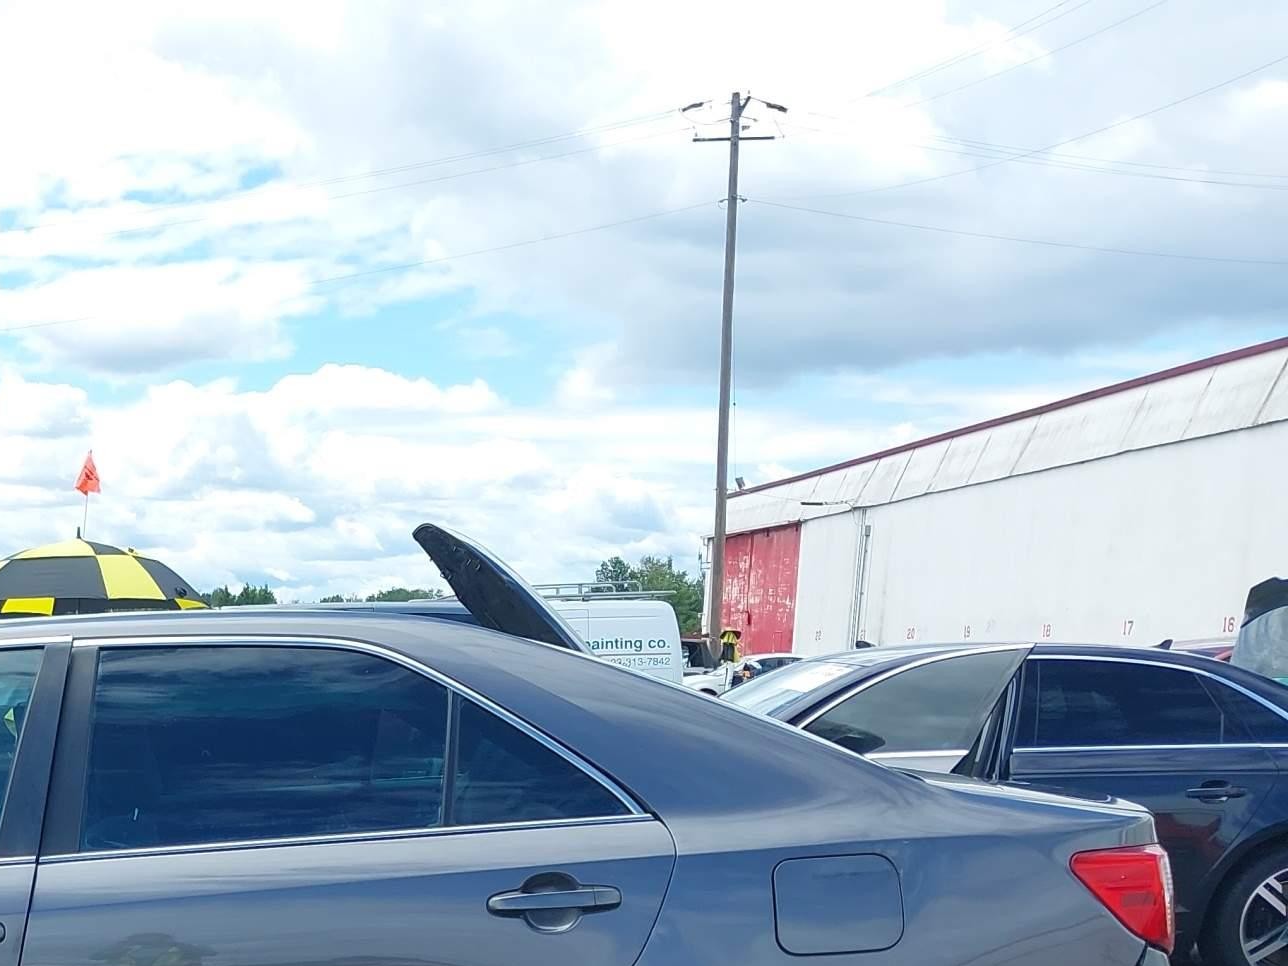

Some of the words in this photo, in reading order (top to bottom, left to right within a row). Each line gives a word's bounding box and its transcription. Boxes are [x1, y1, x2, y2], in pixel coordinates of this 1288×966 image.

[1041, 624, 1051, 637] 18
[1122, 620, 1134, 635] 17
[1222, 616, 1235, 633] 16
[906, 627, 916, 640] 20
[963, 625, 971, 639] 19
[648, 639, 671, 649] co.
[607, 657, 671, 668] 03-313-7842
